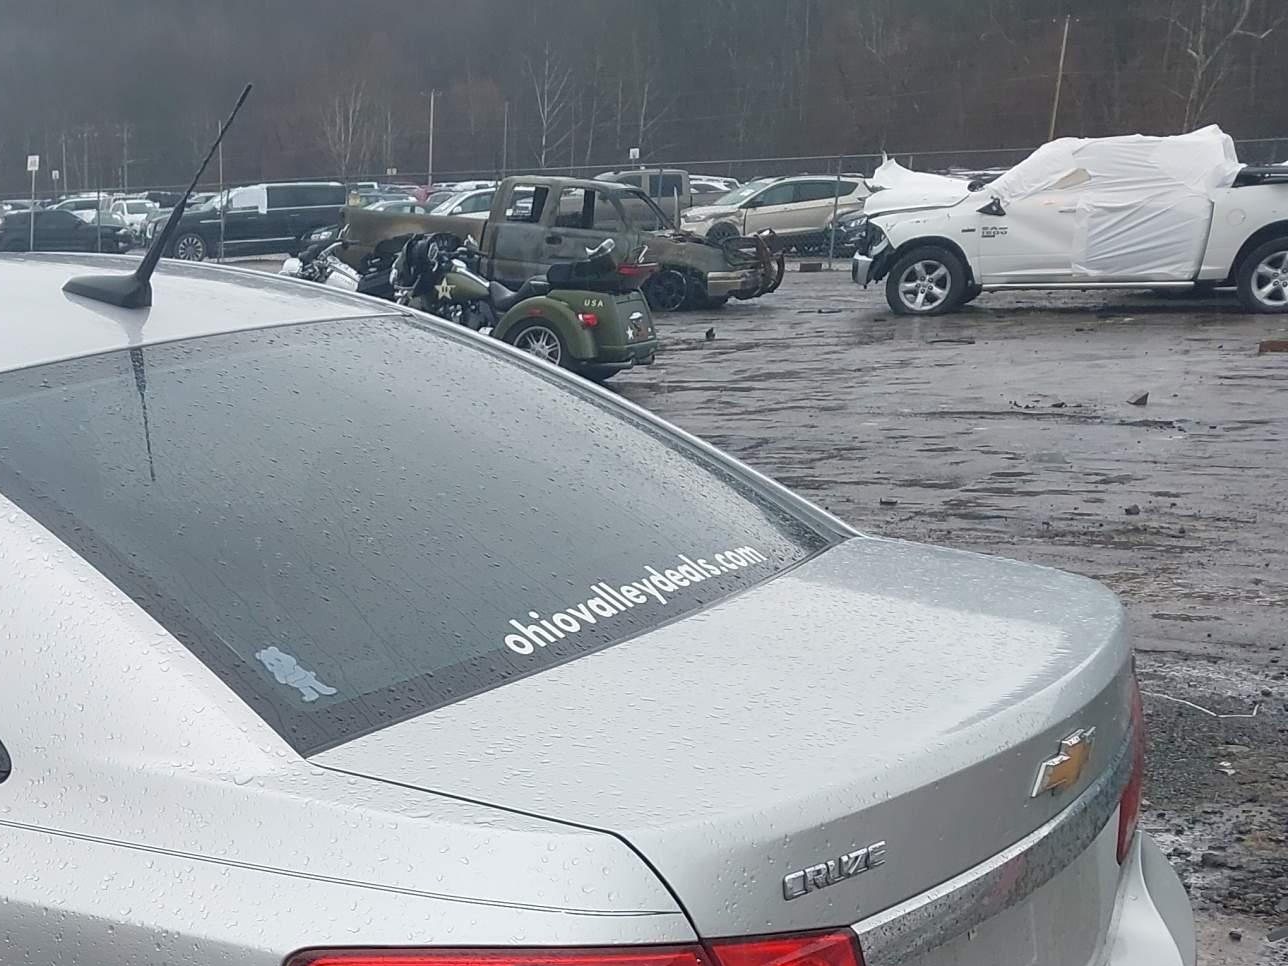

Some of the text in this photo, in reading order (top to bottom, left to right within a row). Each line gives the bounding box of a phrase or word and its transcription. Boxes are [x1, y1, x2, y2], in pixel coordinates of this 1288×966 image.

[584, 298, 604, 307] USA
[504, 543, 768, 655] ohiovalleydeals.com
[782, 840, 887, 901] CRUZE
